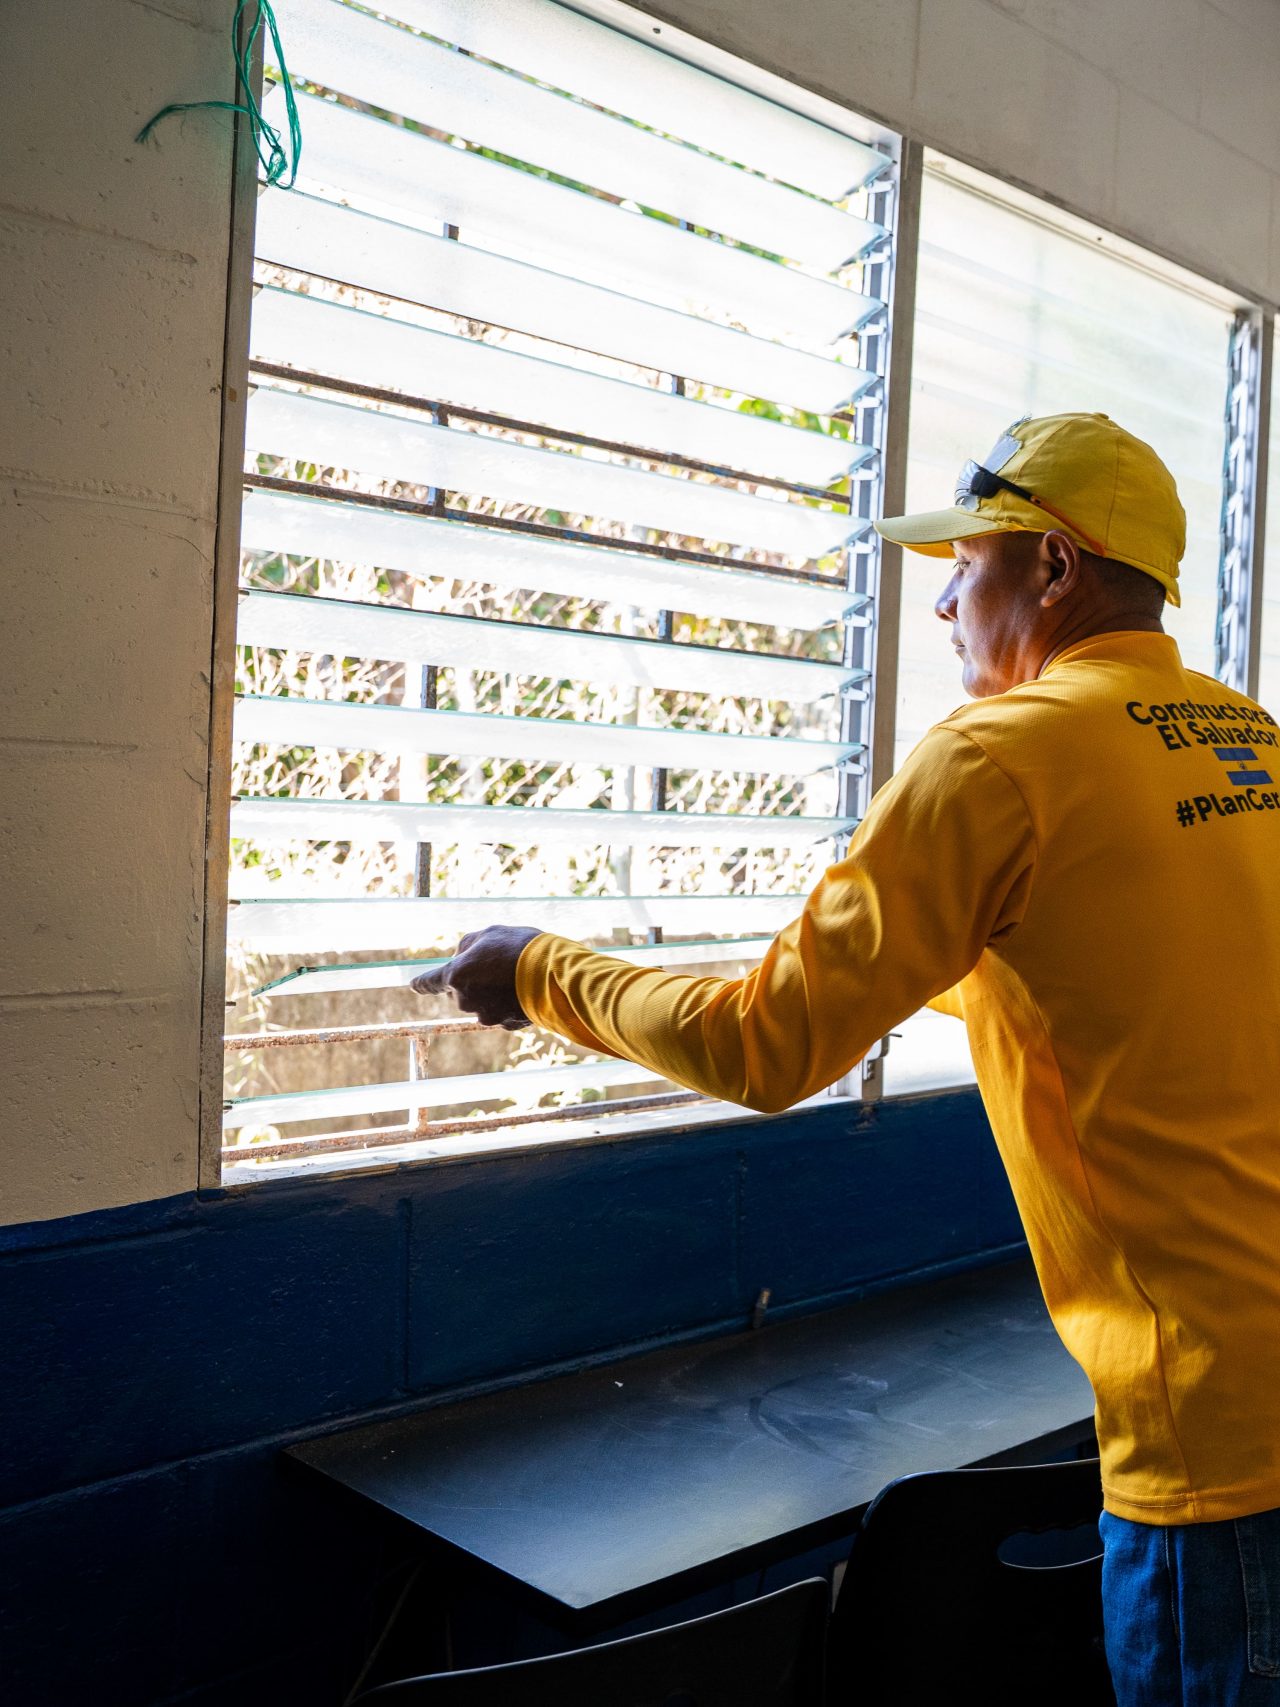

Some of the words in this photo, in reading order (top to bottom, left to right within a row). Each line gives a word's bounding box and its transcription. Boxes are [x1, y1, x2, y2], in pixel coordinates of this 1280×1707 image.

[1126, 700, 1277, 726] Constructora
[1156, 724, 1192, 751] El
[1187, 721, 1279, 748] Salvador
